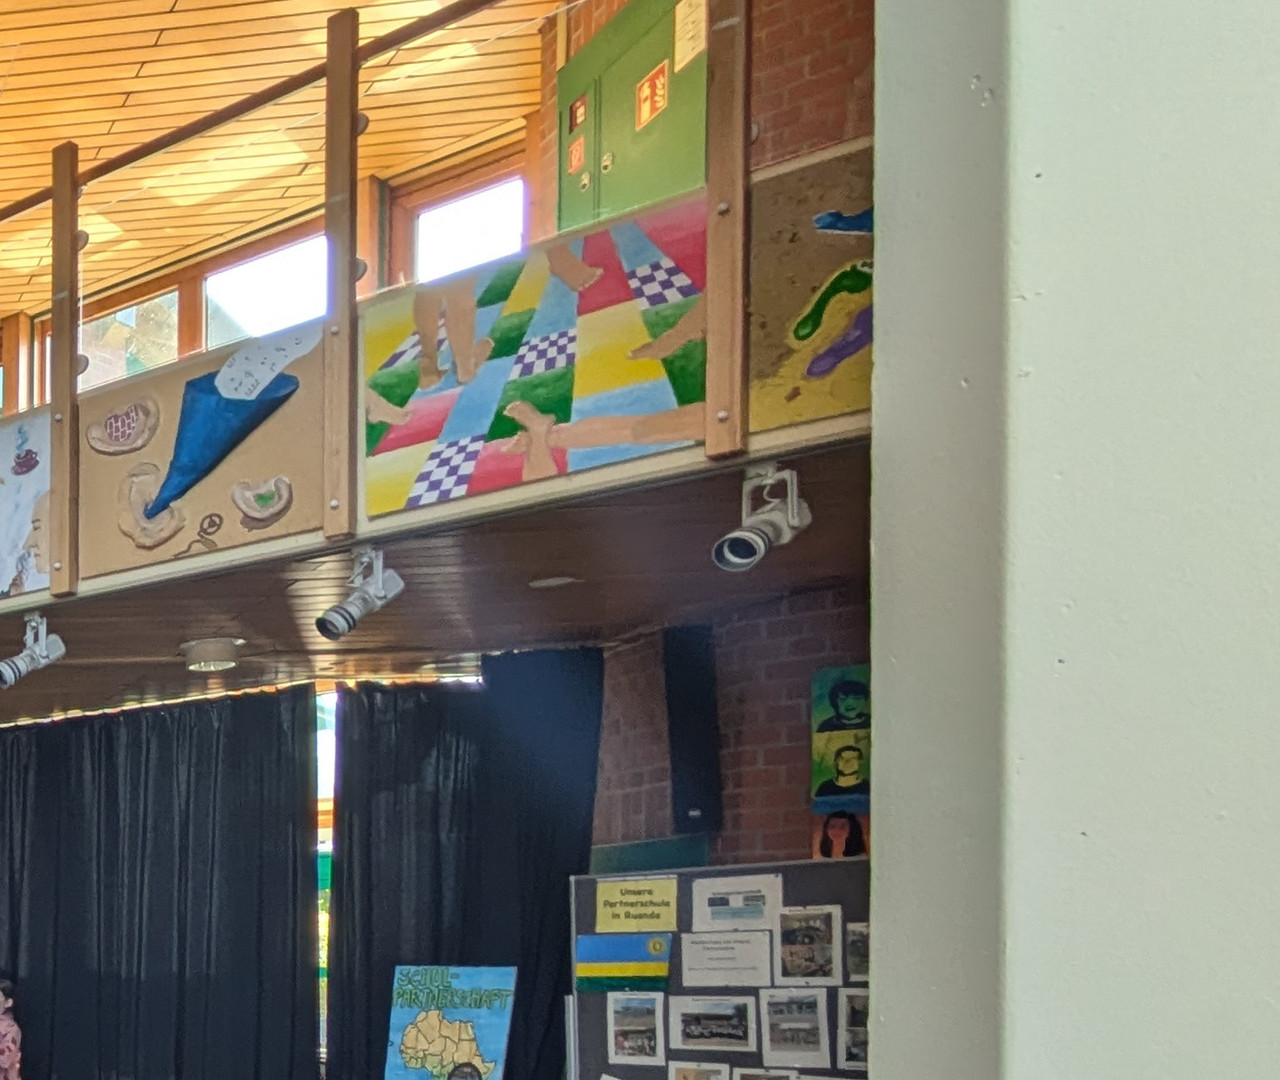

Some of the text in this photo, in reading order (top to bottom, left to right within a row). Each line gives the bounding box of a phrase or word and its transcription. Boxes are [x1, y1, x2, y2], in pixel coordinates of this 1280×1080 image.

[620, 887, 653, 897] Unsere
[604, 899, 670, 908] Partnerschule
[612, 911, 660, 920] in Ruanda
[392, 987, 513, 1009] PARTNERSCHAFT
